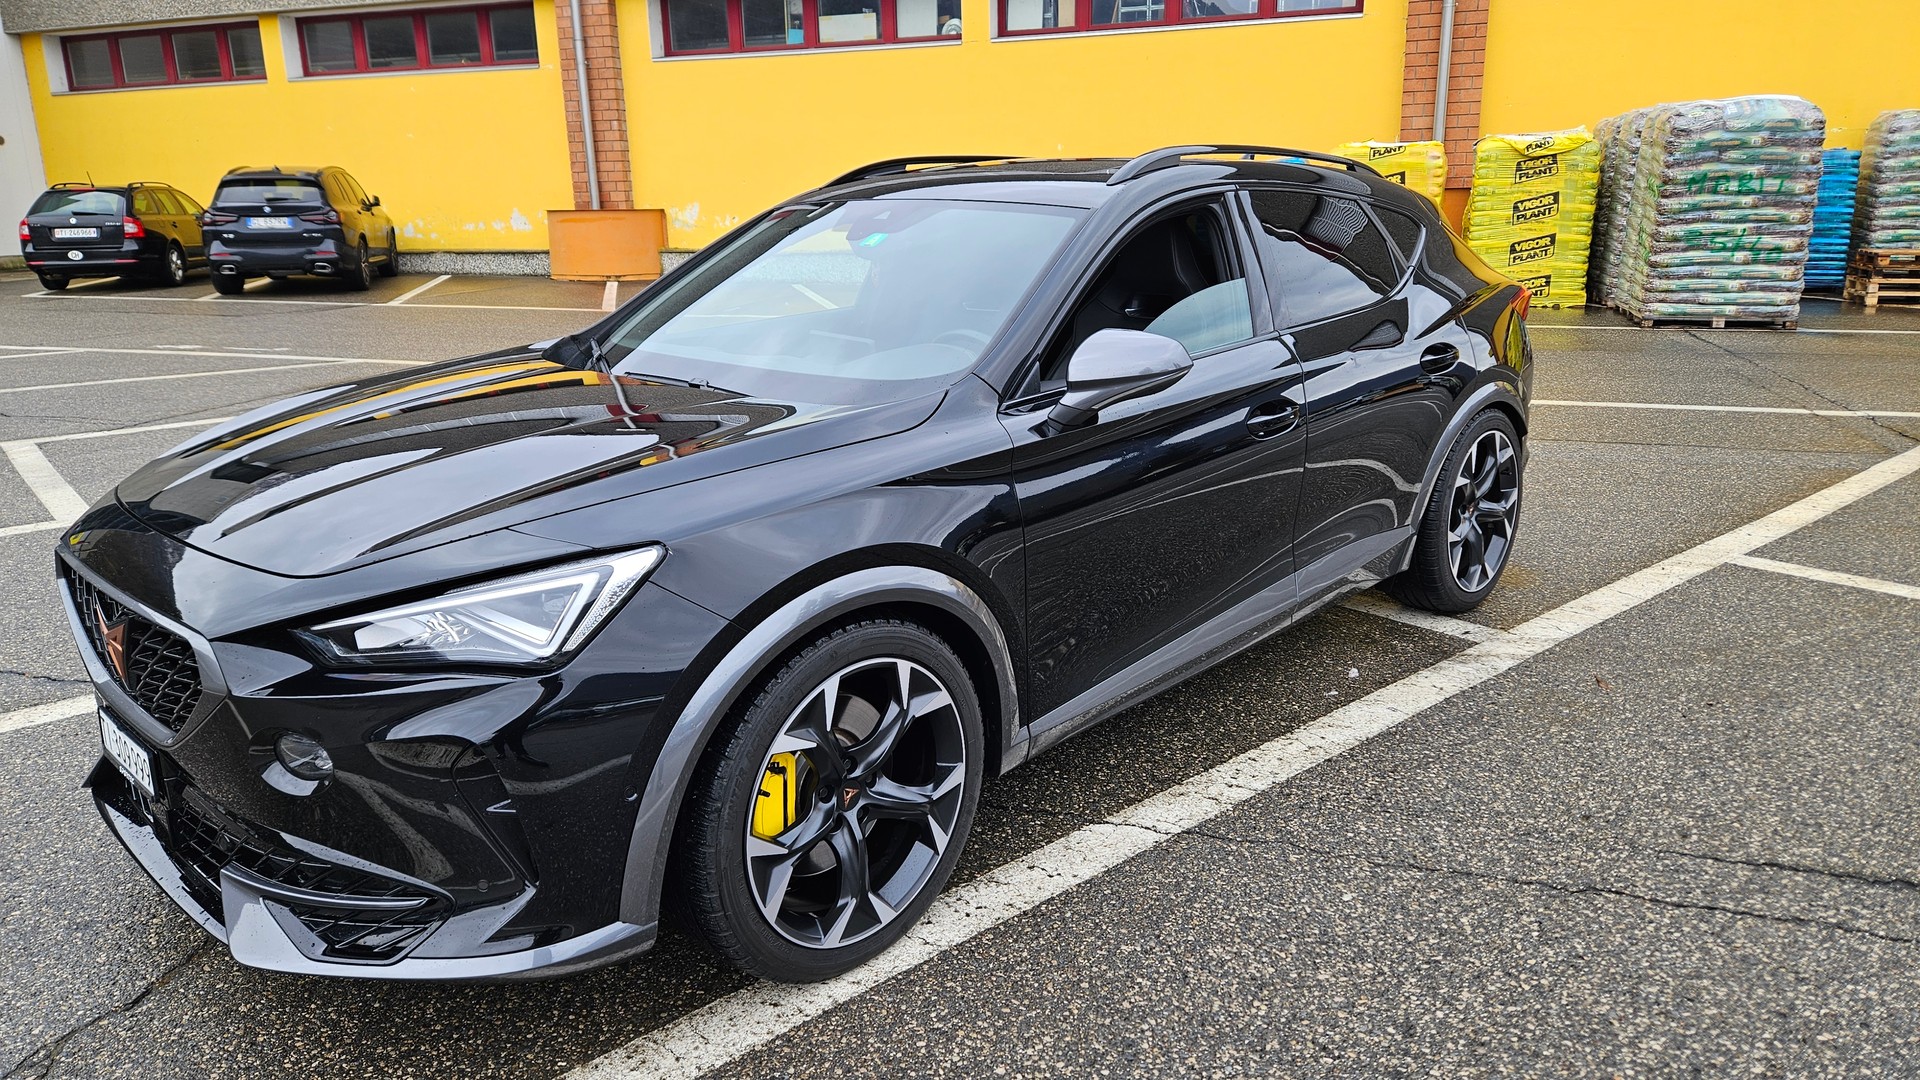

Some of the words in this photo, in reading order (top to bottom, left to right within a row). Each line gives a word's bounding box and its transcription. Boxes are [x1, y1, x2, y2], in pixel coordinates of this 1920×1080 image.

[1372, 146, 1403, 158] PLANT
[1526, 140, 1551, 152] PLANT
[1520, 156, 1554, 169] VIGOR
[1519, 168, 1553, 181] PLANT
[1517, 195, 1554, 211] VIGOR
[1516, 207, 1554, 221] PLANT
[1514, 237, 1551, 252] VIGOR
[1513, 248, 1551, 263] PLANT
[1522, 277, 1547, 289] GOR
